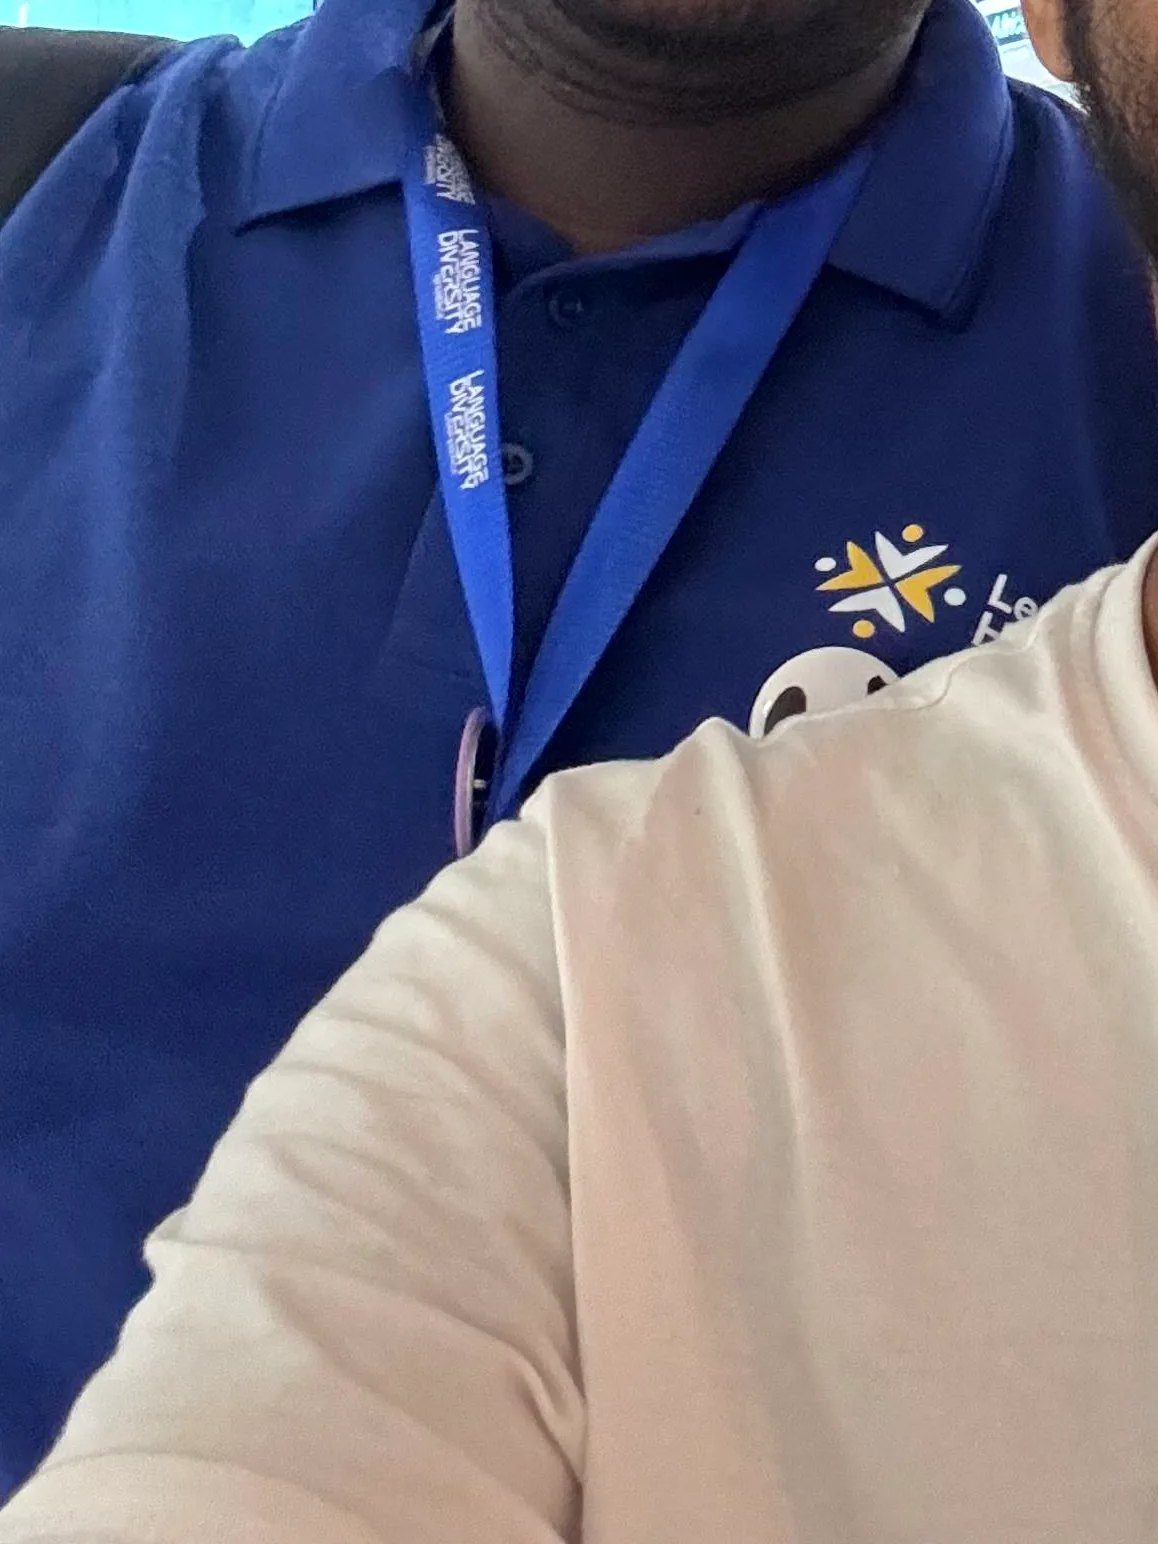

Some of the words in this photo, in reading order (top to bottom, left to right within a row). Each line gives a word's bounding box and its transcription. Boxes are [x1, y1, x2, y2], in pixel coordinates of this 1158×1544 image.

[438, 231, 465, 333] DIVERSITY
[457, 229, 482, 331] LANGUAGE
[449, 377, 475, 490] DIVERSITY
[465, 370, 489, 488] LANGUAGE
